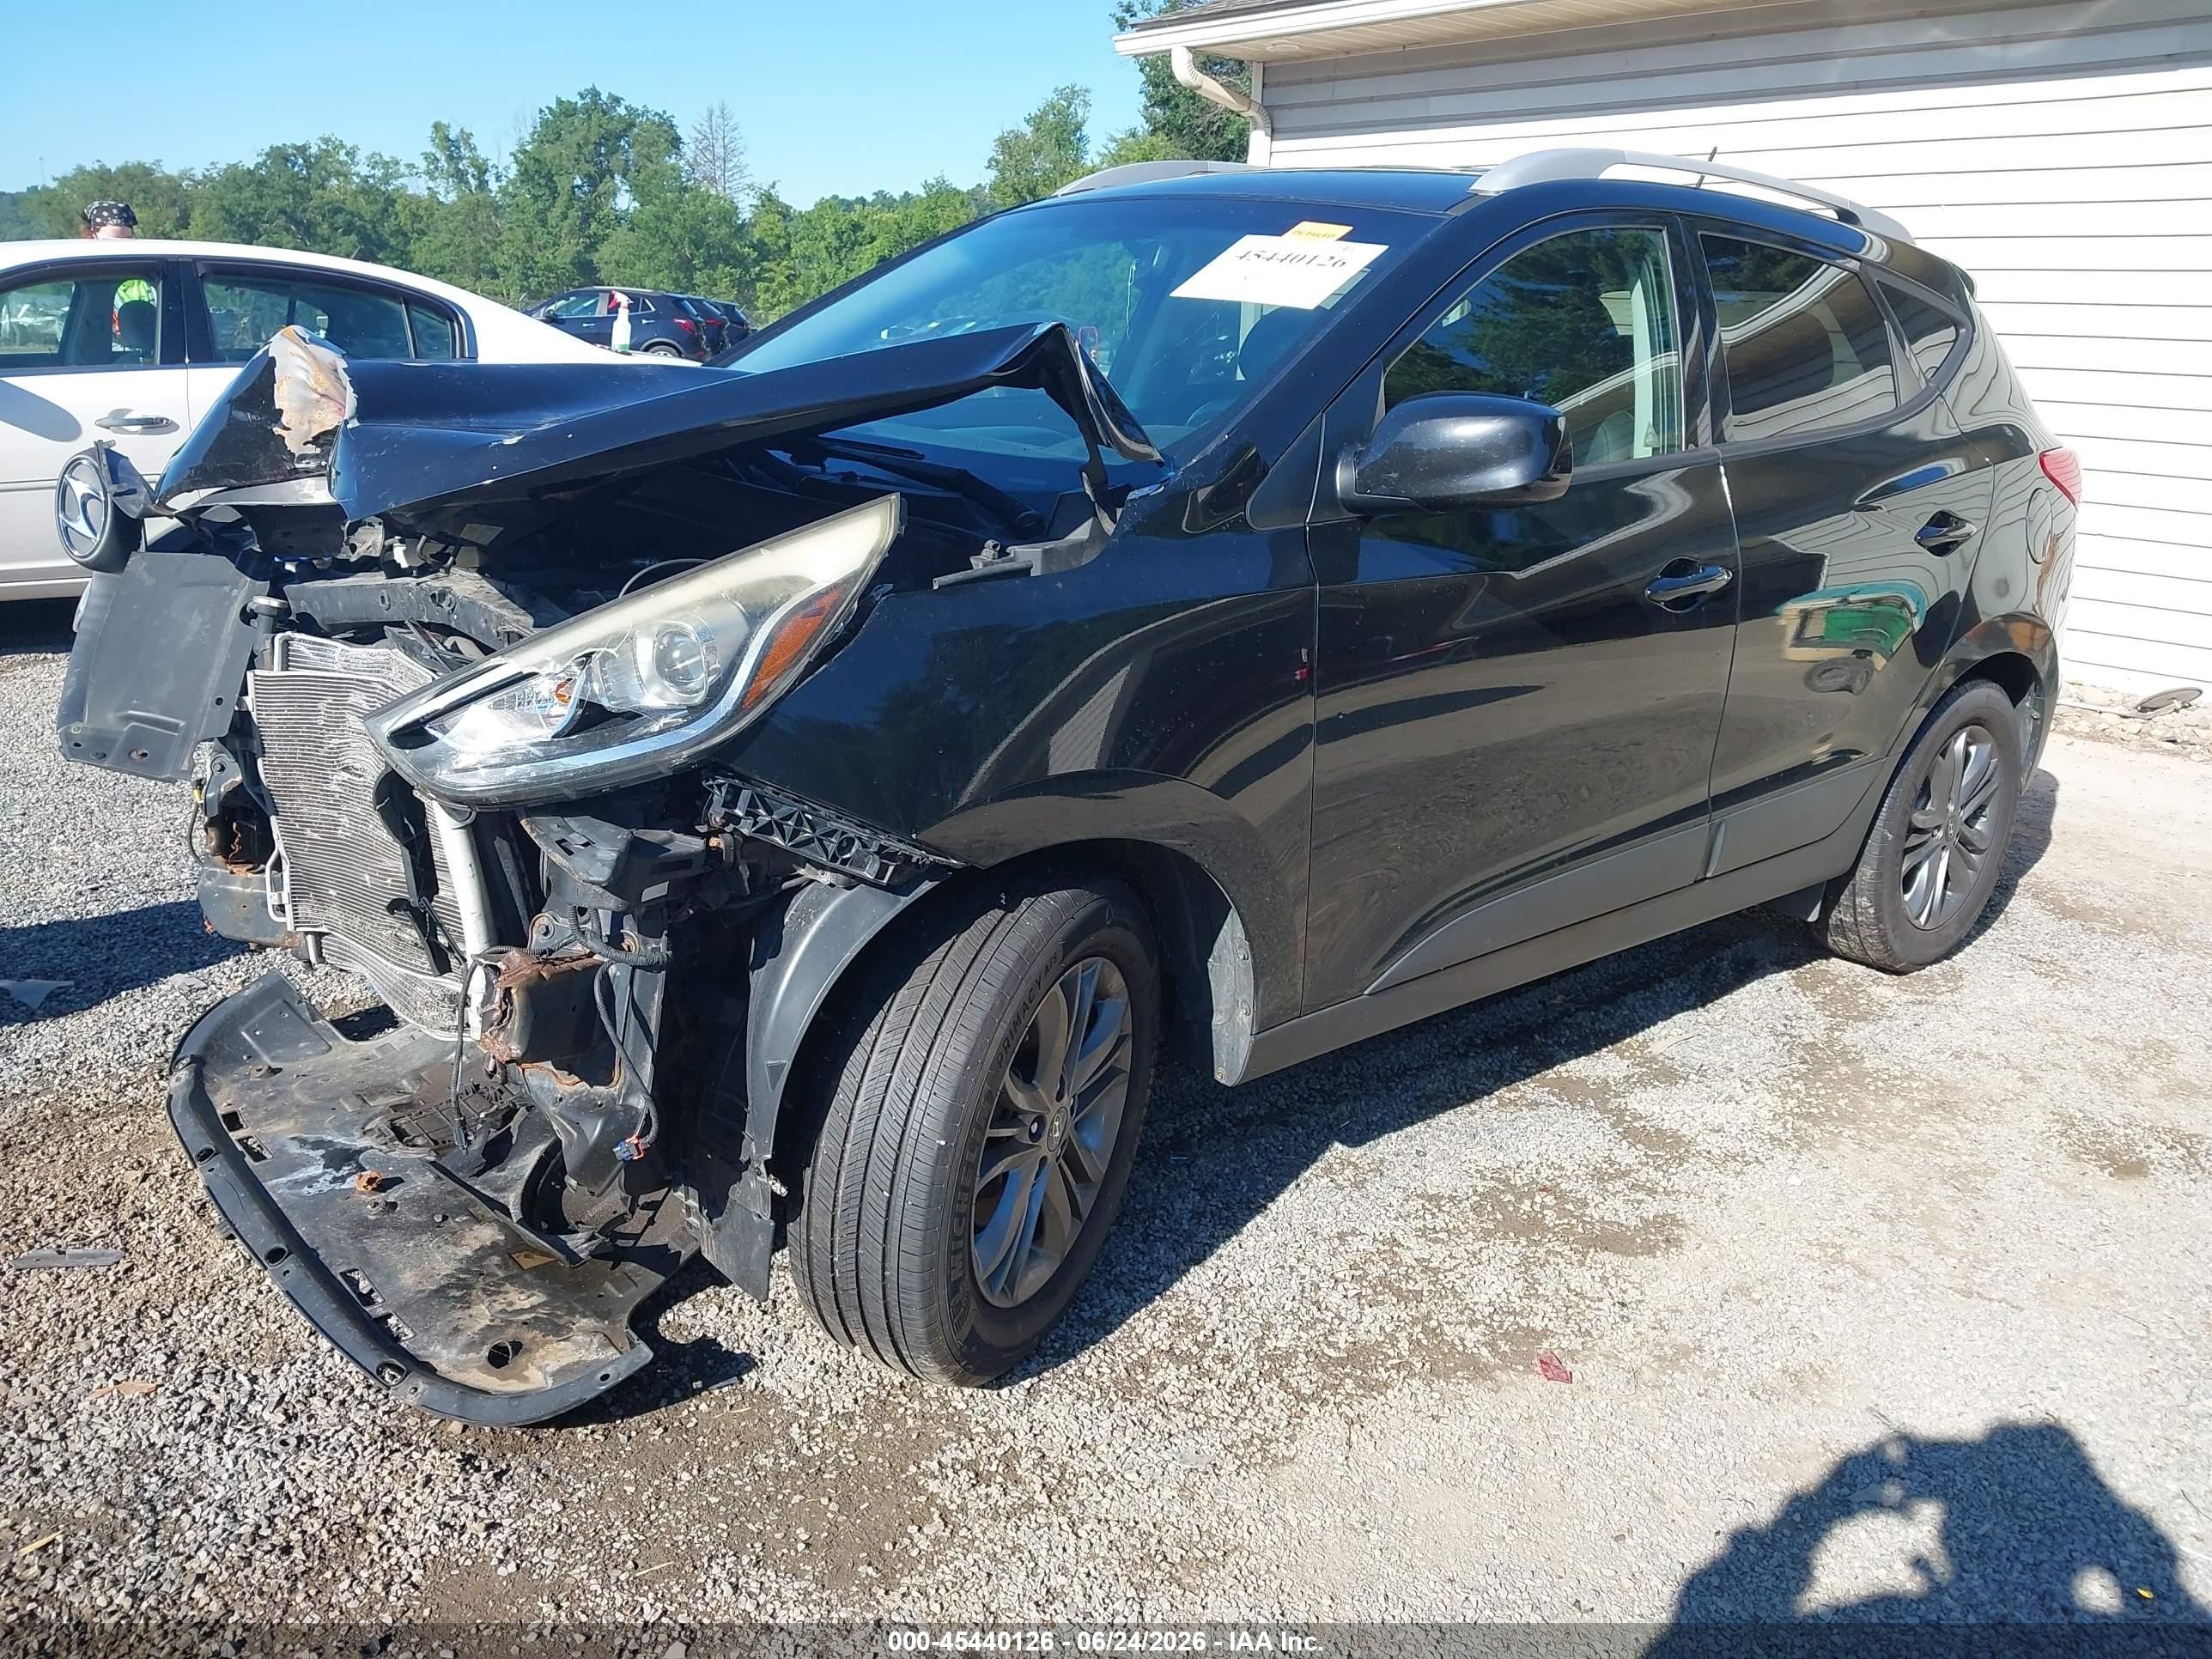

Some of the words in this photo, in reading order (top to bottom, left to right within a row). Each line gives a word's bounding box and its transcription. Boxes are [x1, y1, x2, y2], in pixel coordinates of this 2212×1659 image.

[1236, 249, 1347, 269] 45440126
[995, 971, 1042, 1069] PRIMACY
[950, 1095, 995, 1282] MICHELIN
